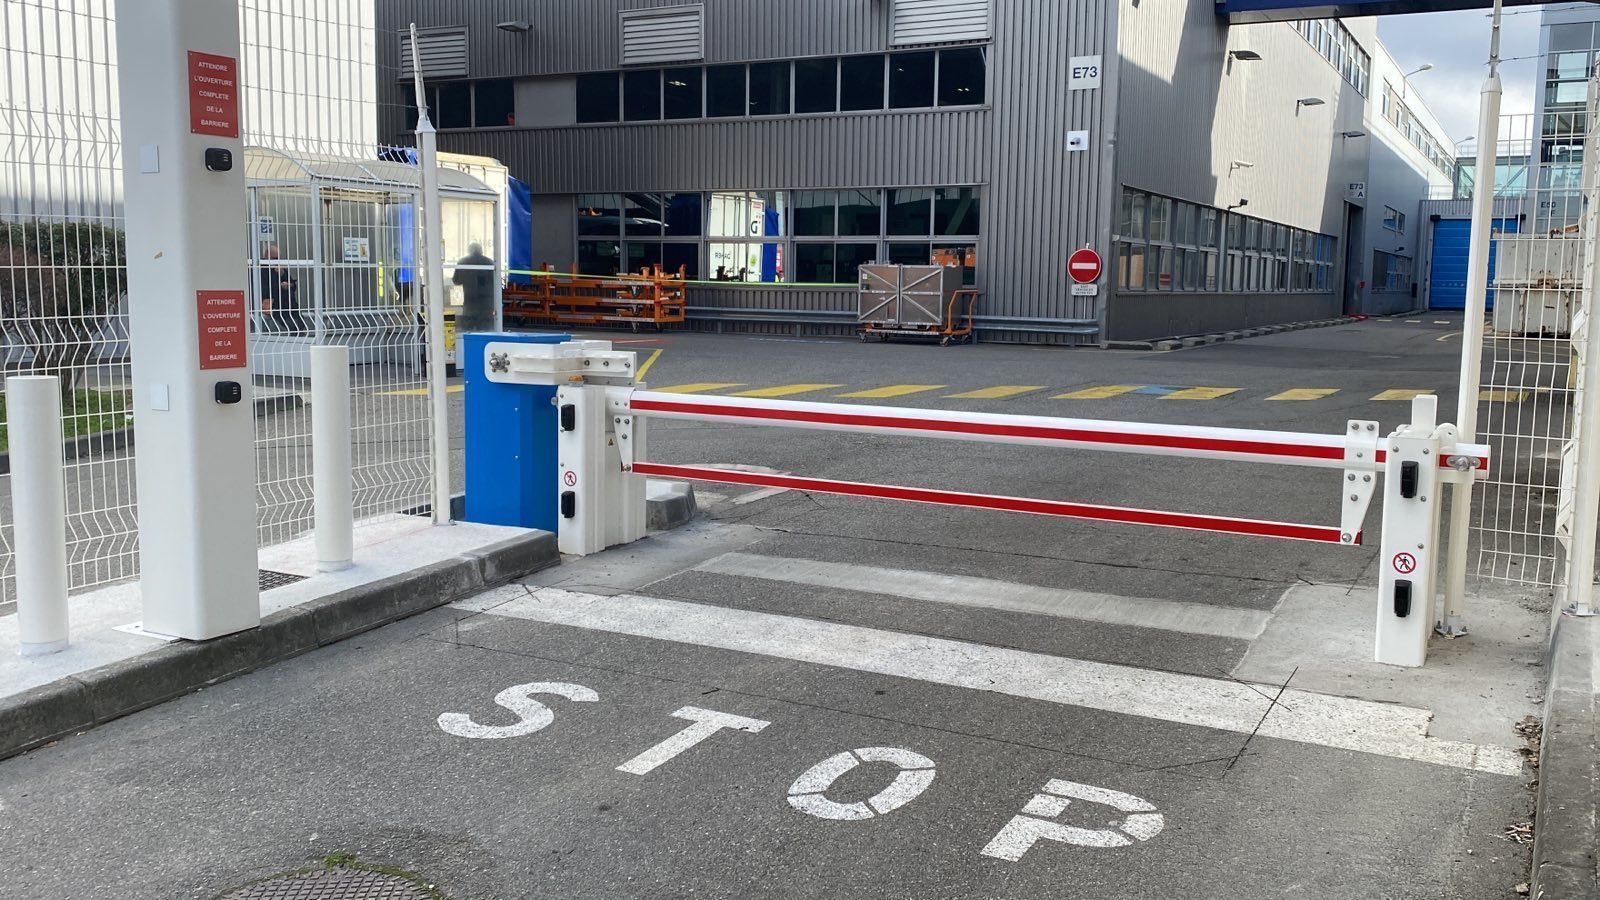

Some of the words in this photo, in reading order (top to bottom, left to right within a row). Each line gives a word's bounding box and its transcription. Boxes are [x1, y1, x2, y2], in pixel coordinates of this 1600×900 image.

[198, 61, 228, 72] ATTENDRE
[1073, 66, 1097, 79] E73
[194, 75, 233, 87] L'OUVERTURE
[198, 90, 229, 100] COMPLETE
[206, 105, 215, 113] DE
[215, 106, 223, 114] LA
[202, 312, 241, 320] L'OUVERTURE
[437, 681, 1166, 862] STOP
